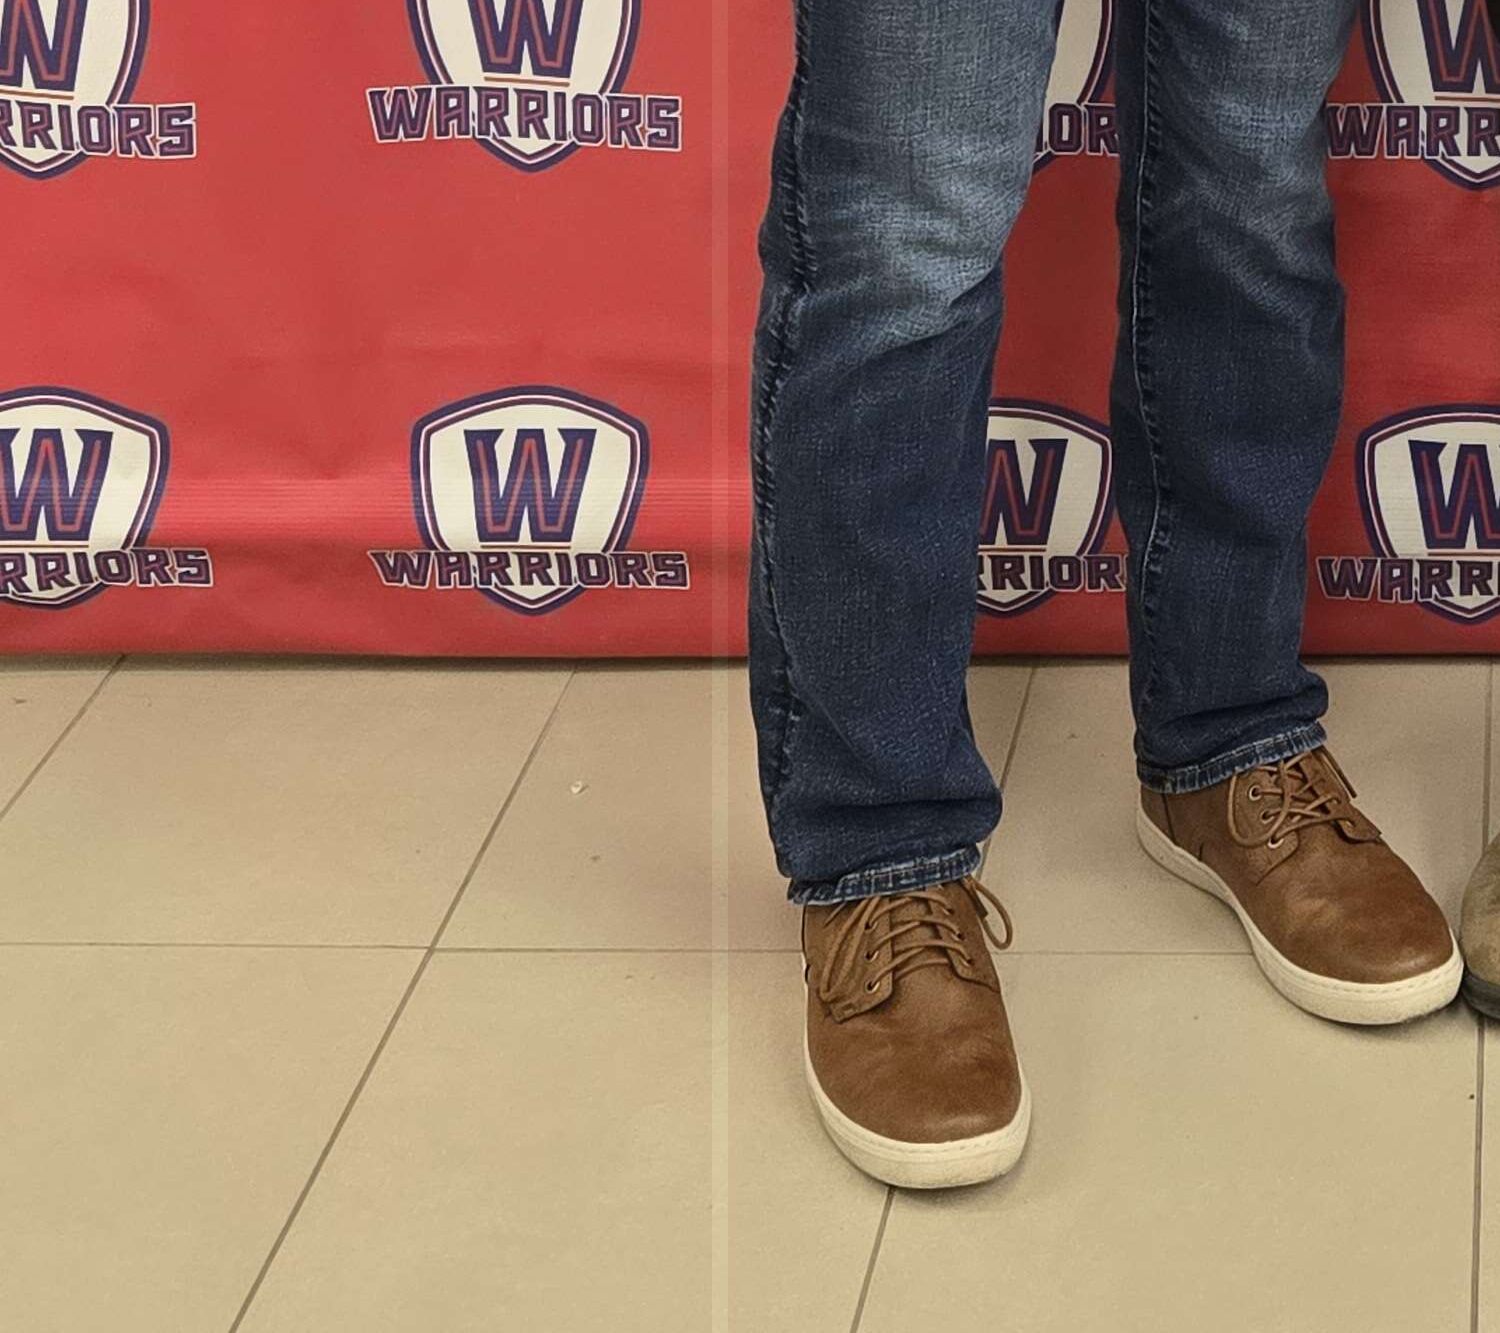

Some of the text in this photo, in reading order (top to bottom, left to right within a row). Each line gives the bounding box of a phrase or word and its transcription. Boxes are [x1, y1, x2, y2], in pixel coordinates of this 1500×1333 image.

[366, 84, 682, 151] WARRIORS
[464, 428, 597, 541] W
[369, 549, 690, 590] WARRIORS
